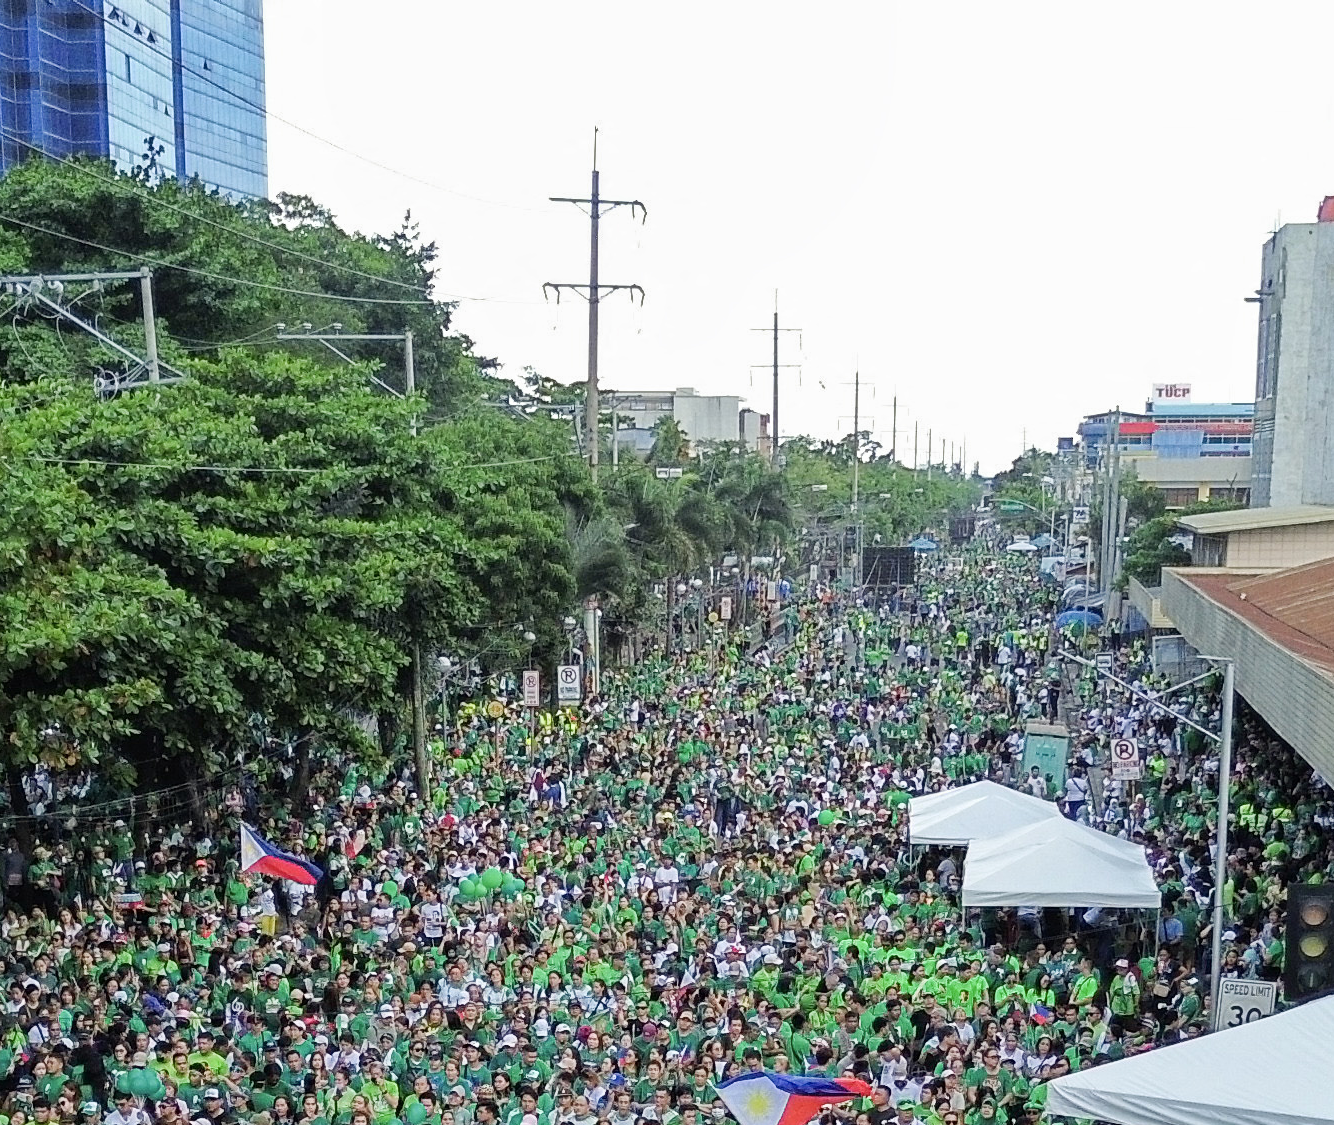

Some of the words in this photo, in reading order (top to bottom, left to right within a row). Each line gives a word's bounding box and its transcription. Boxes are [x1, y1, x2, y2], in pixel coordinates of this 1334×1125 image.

[1224, 983, 1249, 996] SPEED
[1250, 986, 1271, 998] LIMIT
[1227, 1005, 1263, 1028] 30
